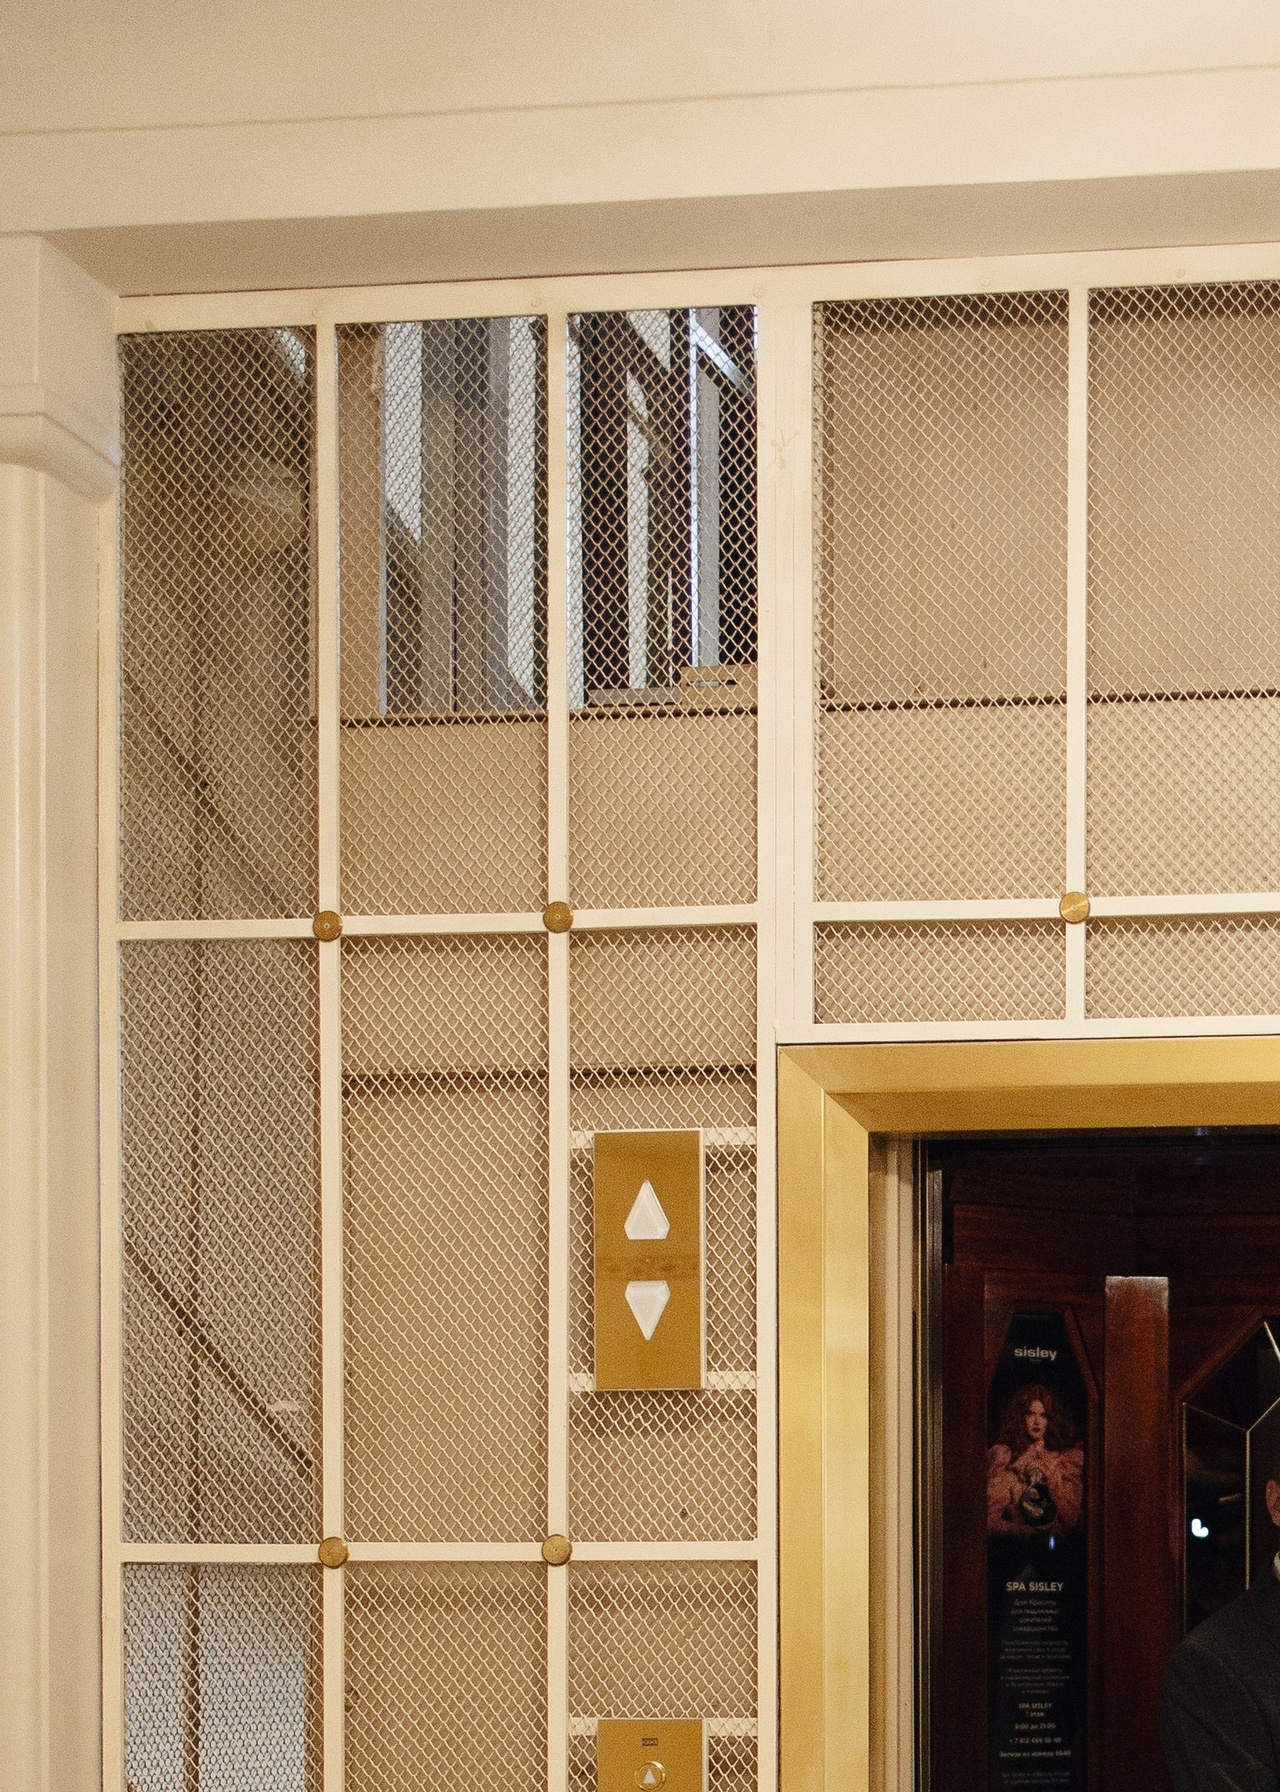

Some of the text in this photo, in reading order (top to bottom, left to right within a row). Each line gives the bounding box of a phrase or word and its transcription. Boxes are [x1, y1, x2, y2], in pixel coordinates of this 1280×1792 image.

[1014, 1345, 1057, 1361] sisley
[1005, 1580, 1065, 1592] SPA SISLEY
